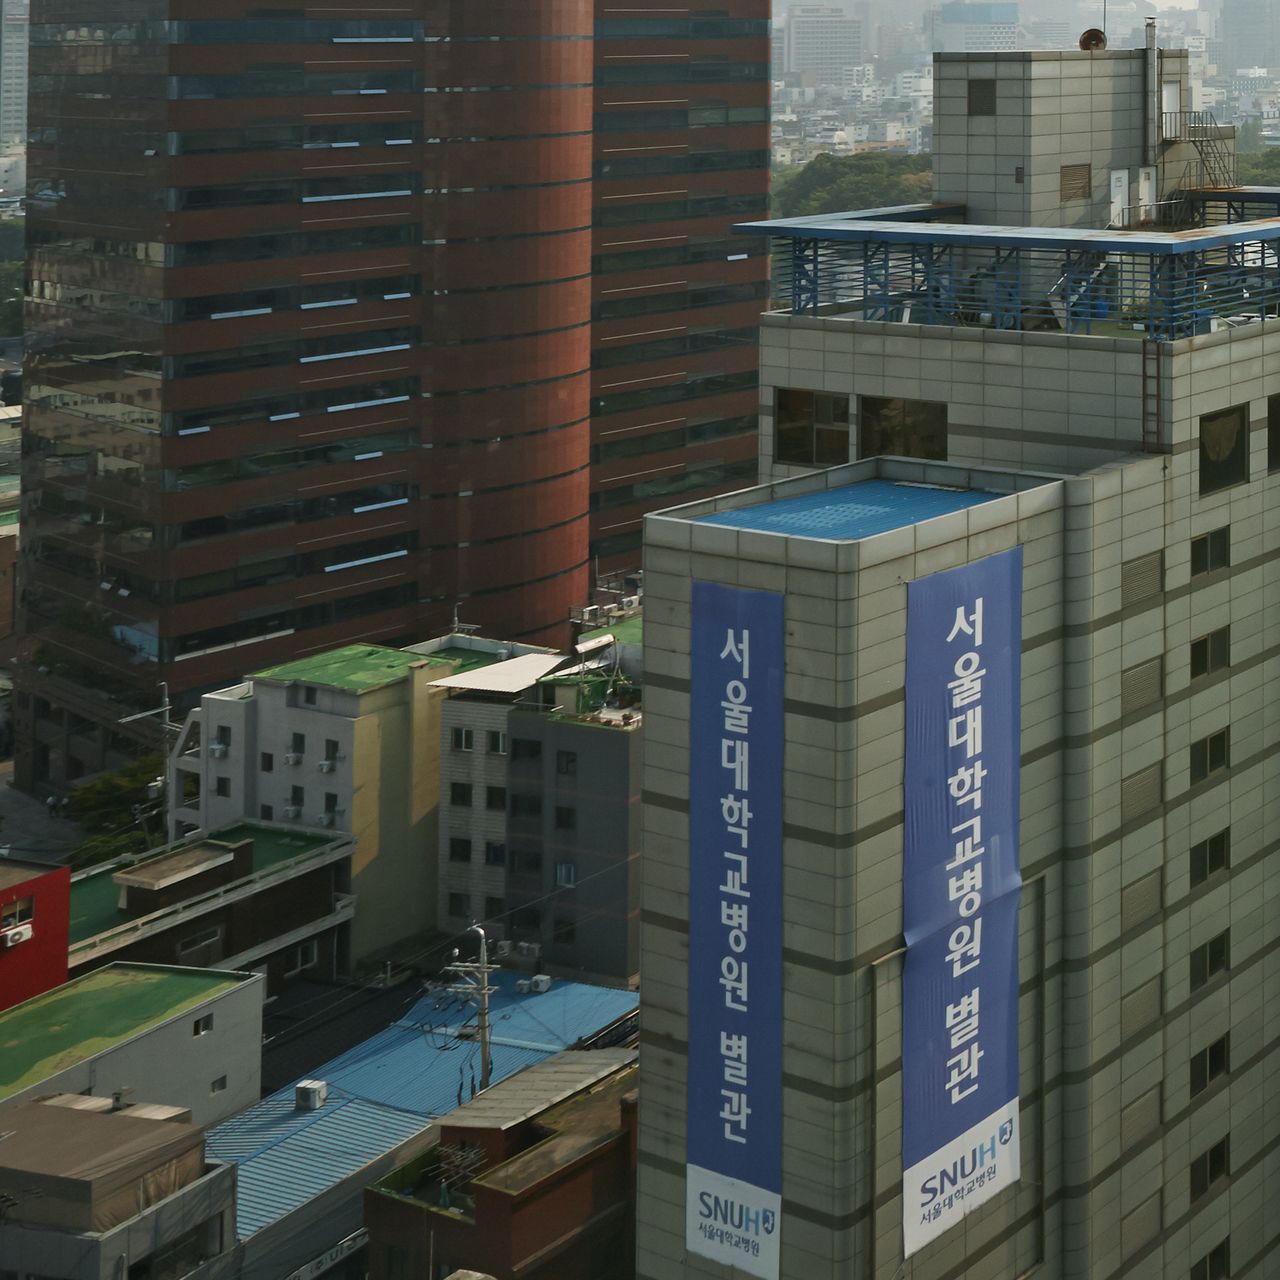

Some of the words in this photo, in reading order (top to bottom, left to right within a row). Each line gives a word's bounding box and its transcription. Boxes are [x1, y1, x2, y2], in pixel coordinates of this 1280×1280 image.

[719, 627, 754, 1013] 서울대학교병원
[945, 596, 988, 978] 서울대학교병원
[719, 1030, 749, 1145] 별관
[945, 995, 987, 1106] 별관
[699, 1191, 760, 1236] SNUH
[920, 1135, 997, 1208] SNUH
[920, 1163, 997, 1225] 서울대학교병원
[698, 1221, 760, 1257] 서울대학교병원
